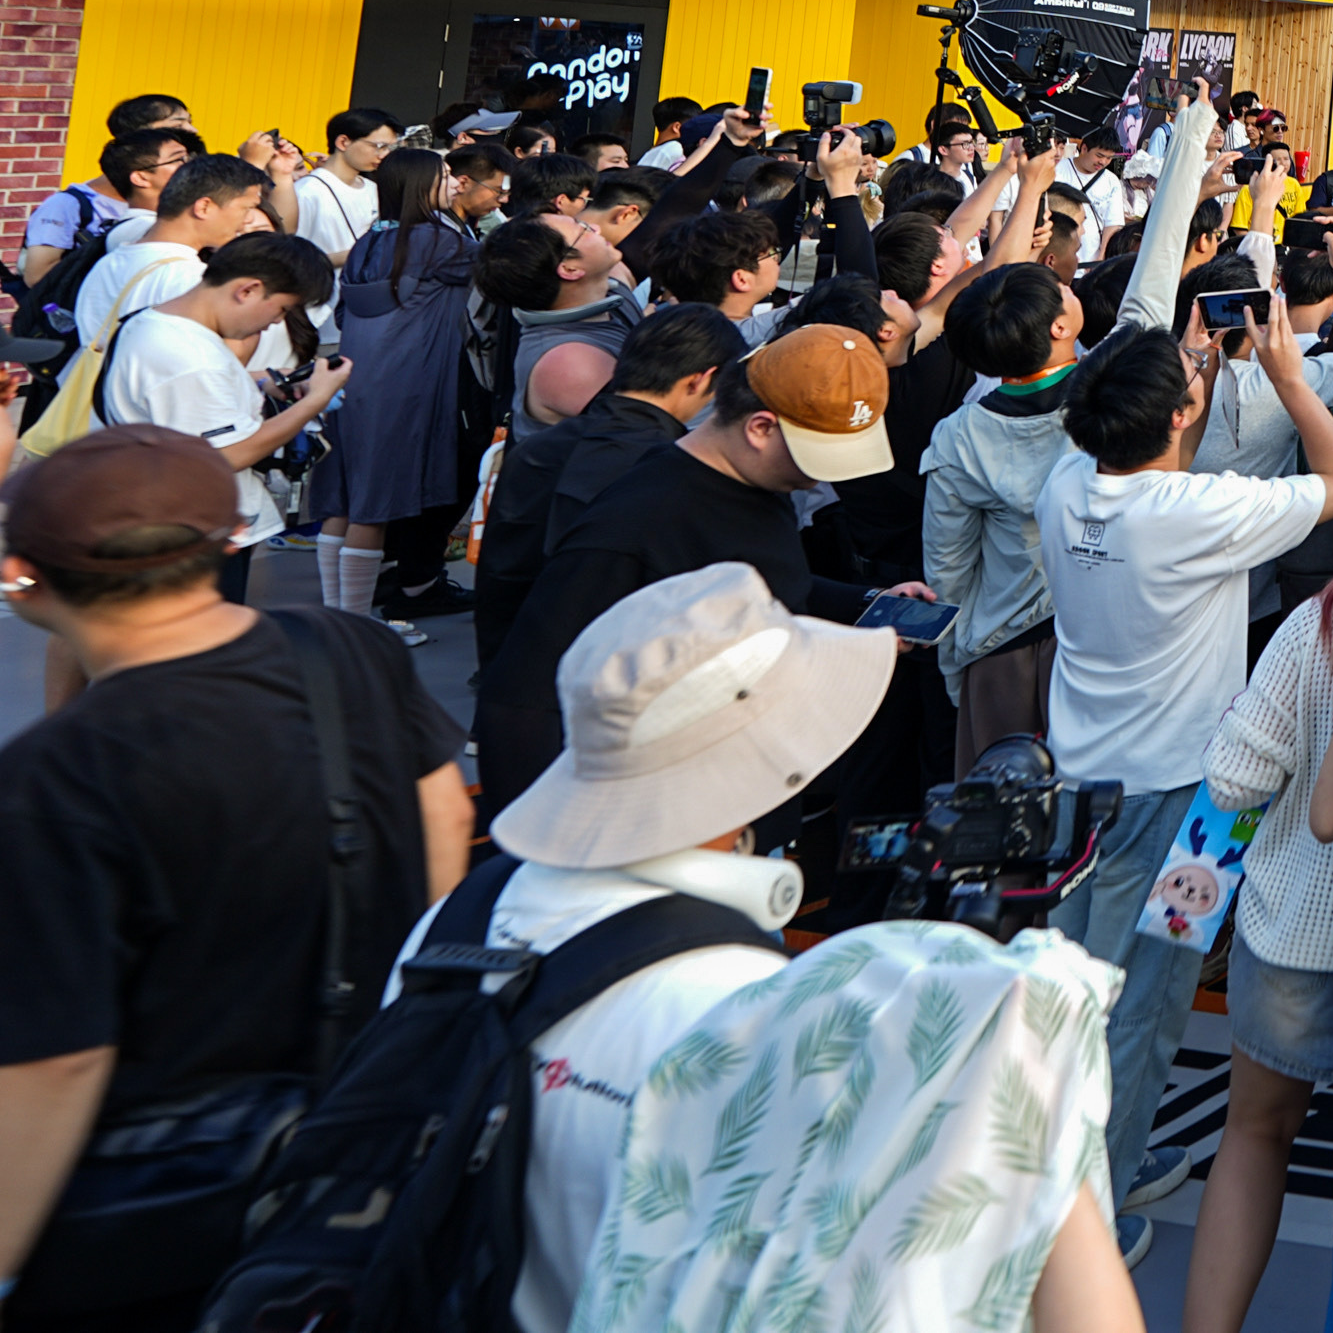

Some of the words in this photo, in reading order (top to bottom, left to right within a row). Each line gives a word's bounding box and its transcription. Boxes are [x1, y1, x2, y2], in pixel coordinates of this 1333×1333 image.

[1139, 33, 1173, 64] ARK
[1179, 33, 1235, 61] LYCAON
[849, 400, 873, 427] LA
